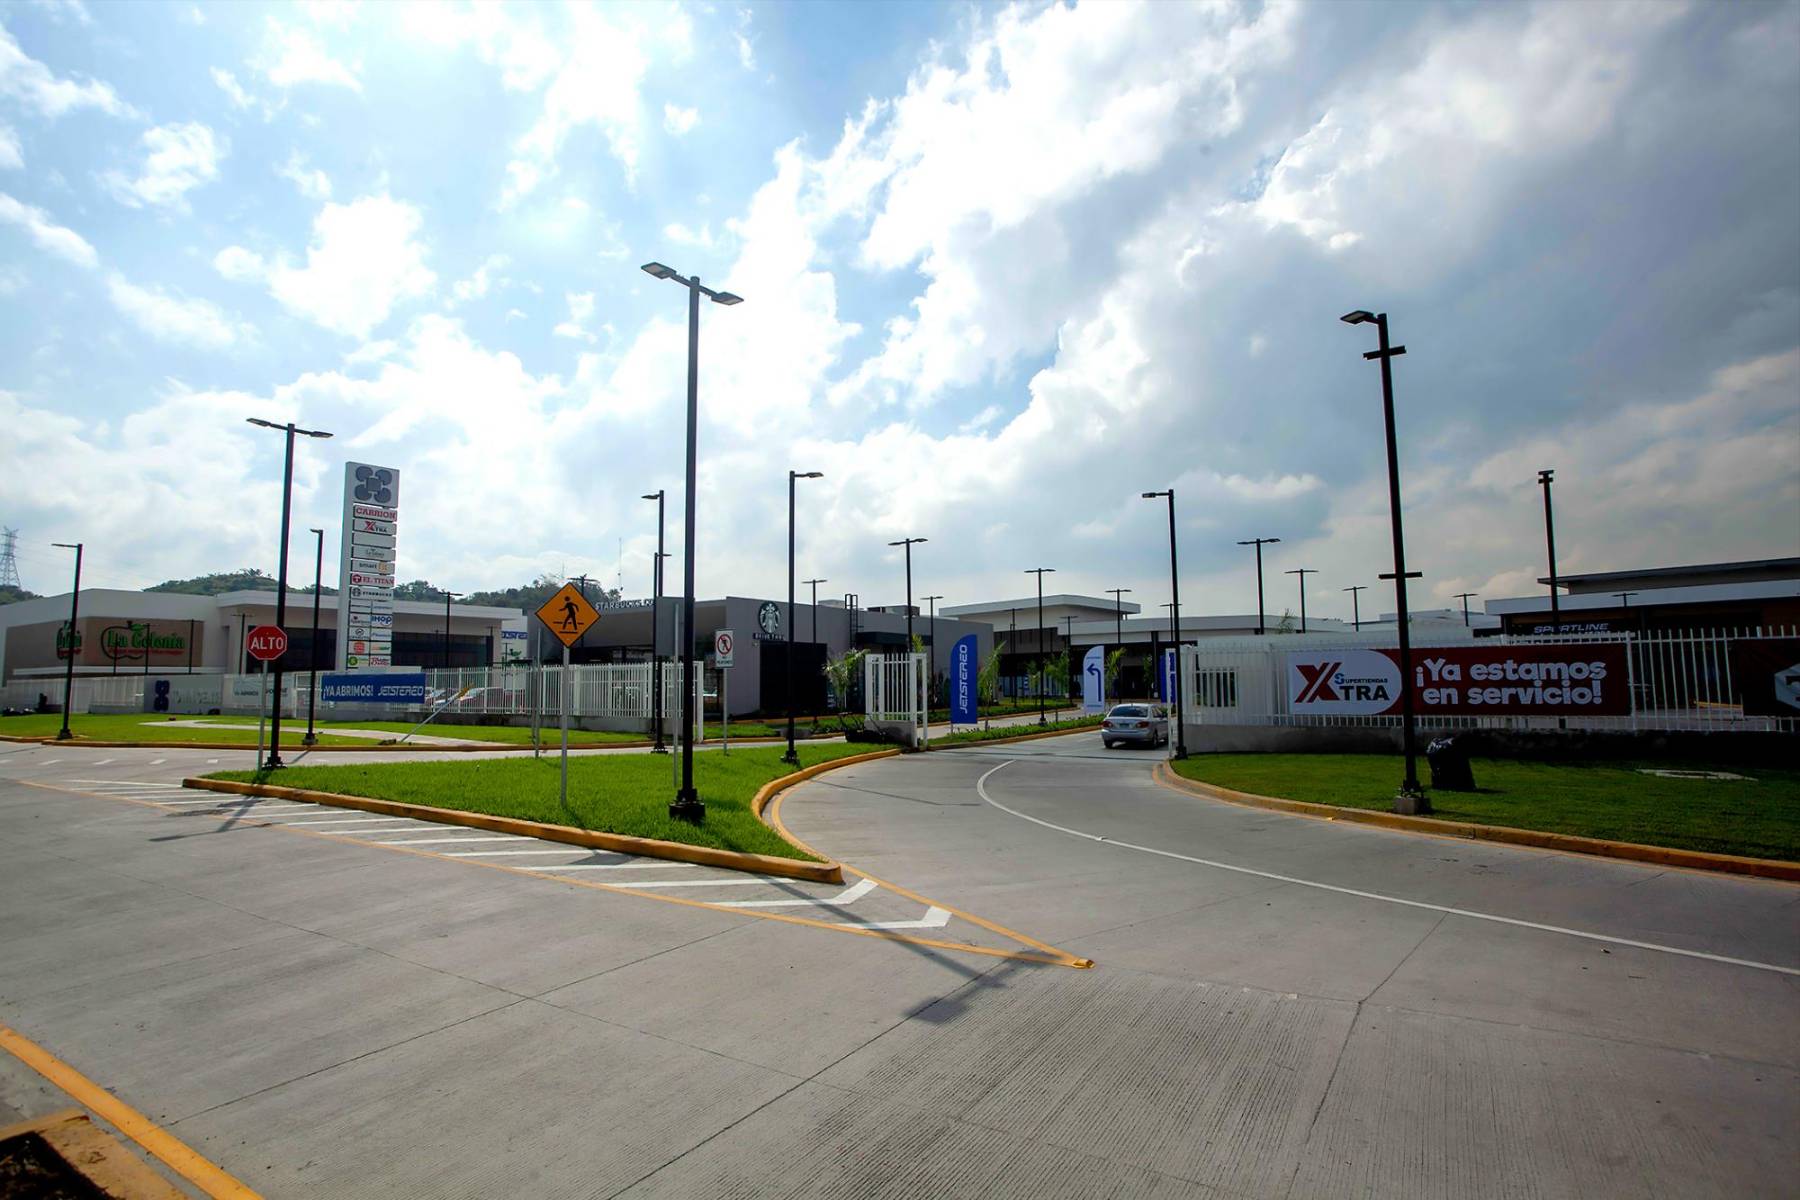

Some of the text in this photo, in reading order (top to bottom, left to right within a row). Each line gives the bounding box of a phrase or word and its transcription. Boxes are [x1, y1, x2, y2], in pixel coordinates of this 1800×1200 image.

[1534, 623, 1608, 633] SPRTLINE
[251, 637, 284, 650] ALTO
[960, 644, 968, 714] JETSTEREO
[1469, 660, 1607, 681] estamos
[378, 685, 423, 696] JETSTEREO
[1423, 680, 1602, 705] en servicio!
